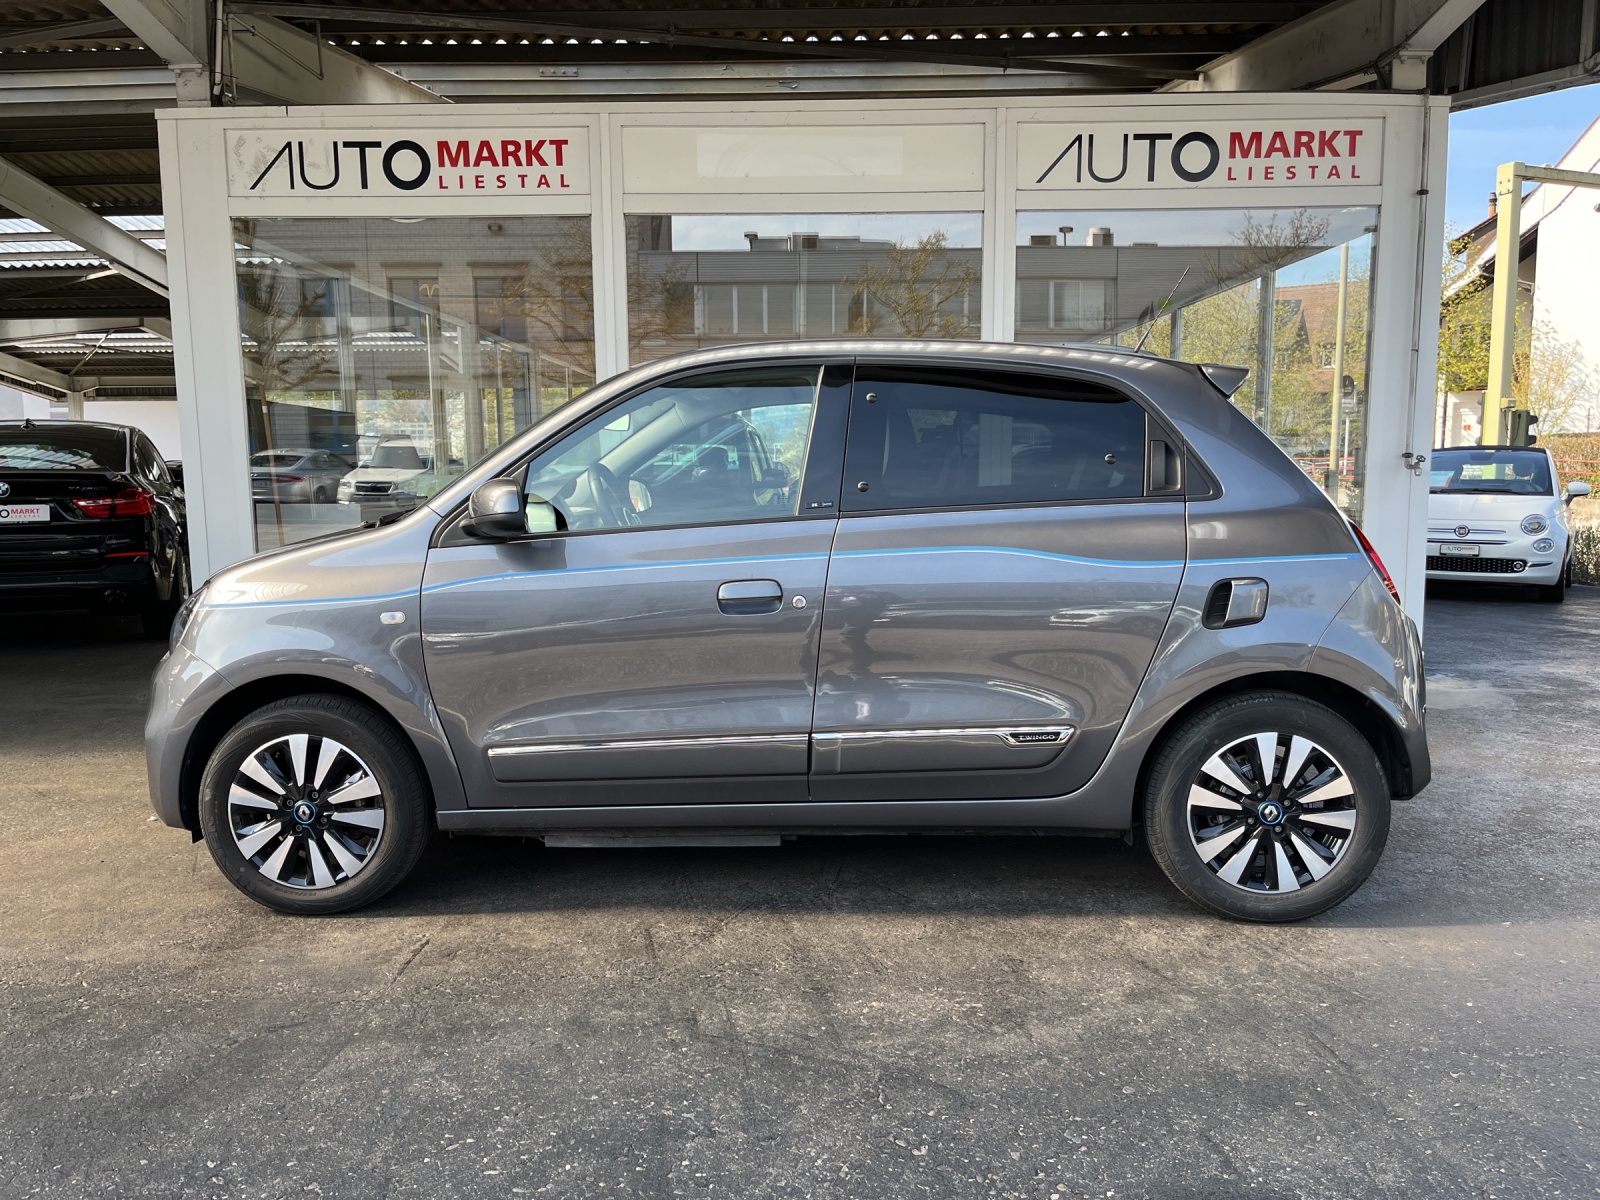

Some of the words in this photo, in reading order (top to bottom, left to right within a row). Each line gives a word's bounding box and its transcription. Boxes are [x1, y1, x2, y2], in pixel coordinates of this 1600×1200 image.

[249, 140, 431, 190] AUTO
[436, 139, 569, 168] MARKT
[1035, 131, 1220, 184] AUTO
[1228, 130, 1363, 159] MARKT
[1227, 164, 1361, 181] LIESTAL
[438, 173, 570, 190] LIESTAL
